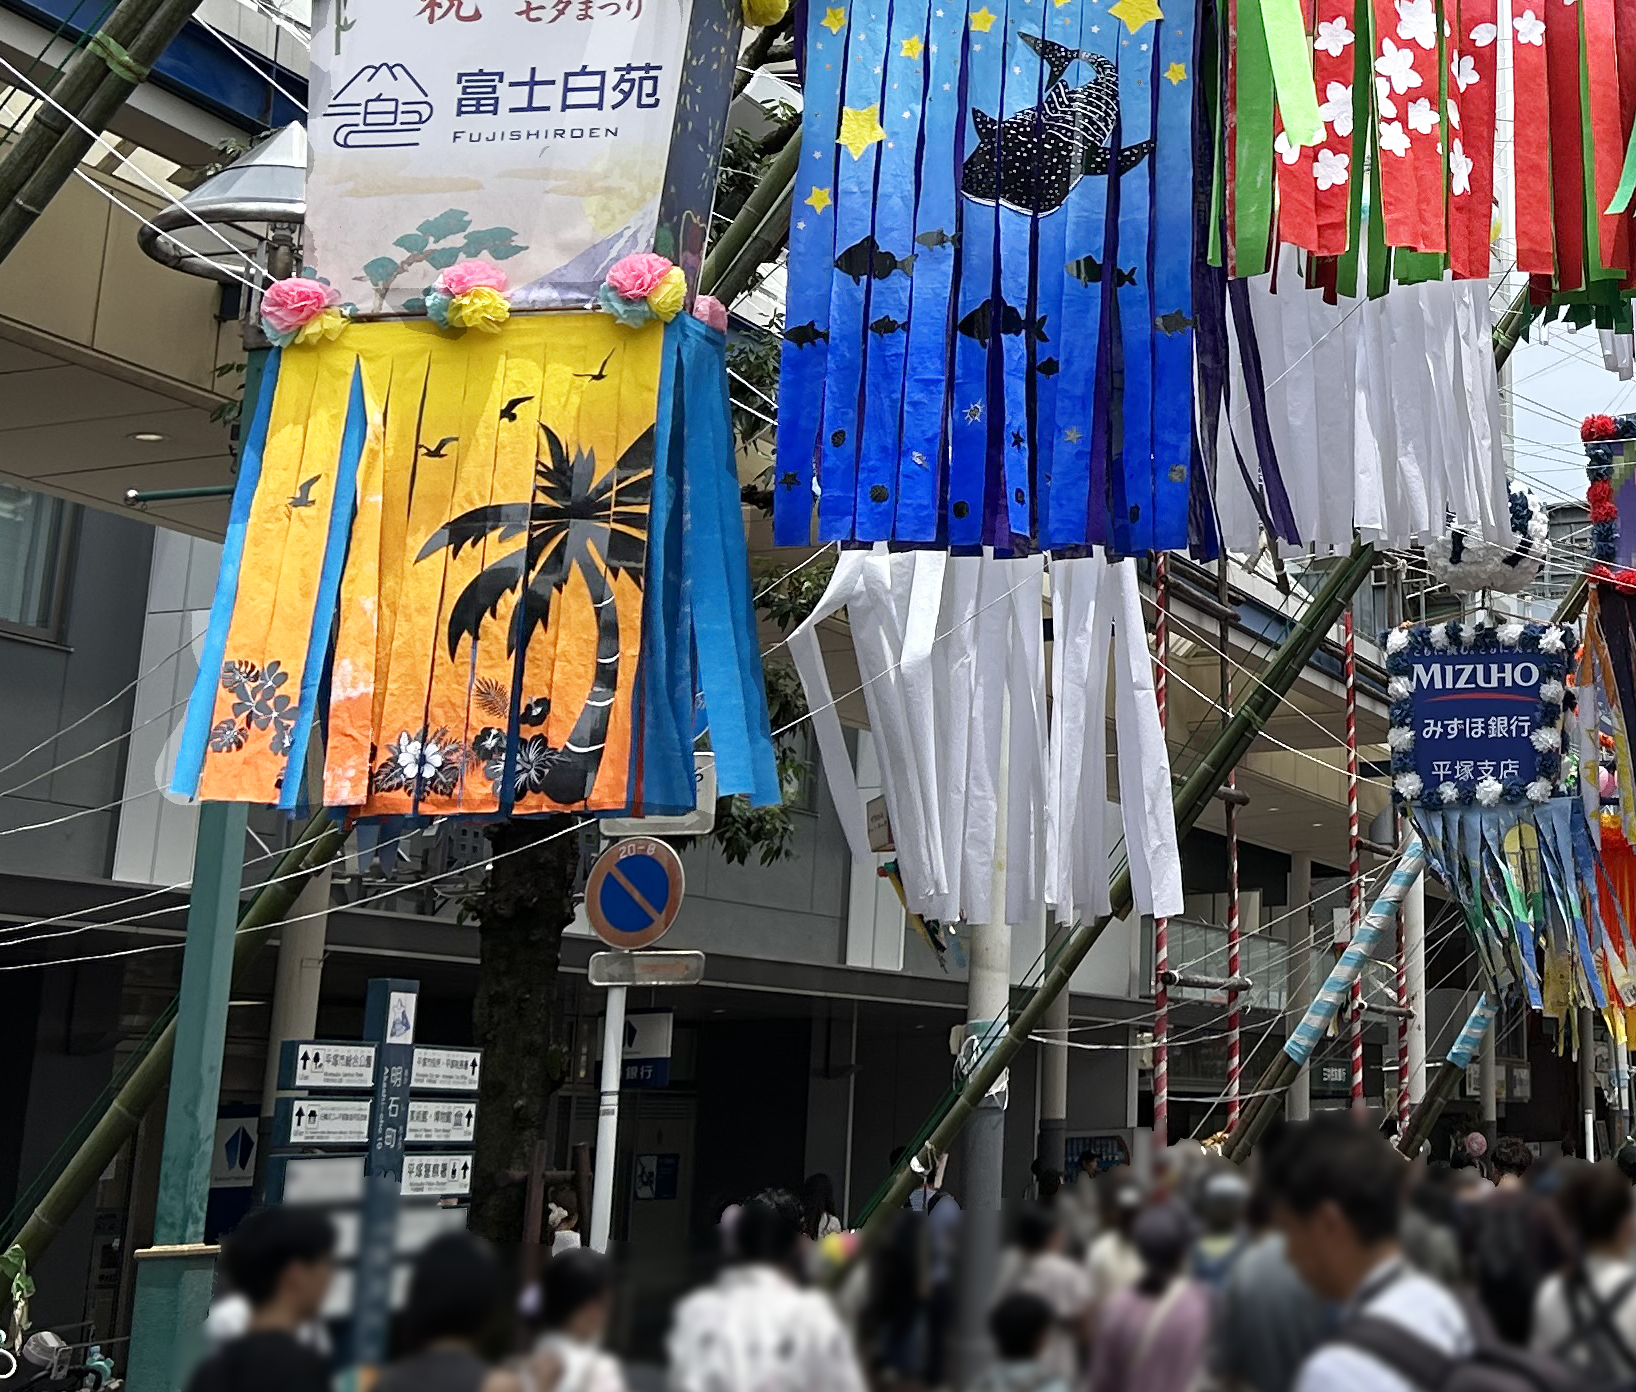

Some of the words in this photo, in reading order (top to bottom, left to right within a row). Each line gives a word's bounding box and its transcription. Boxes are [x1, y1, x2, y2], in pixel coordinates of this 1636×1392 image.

[455, 62, 663, 118] 富士白苑
[1412, 662, 1540, 690] MIZUHO
[1422, 715, 1531, 739] みずほ銀行
[1431, 758, 1521, 782] 平塚支店
[618, 842, 657, 859] 20-8
